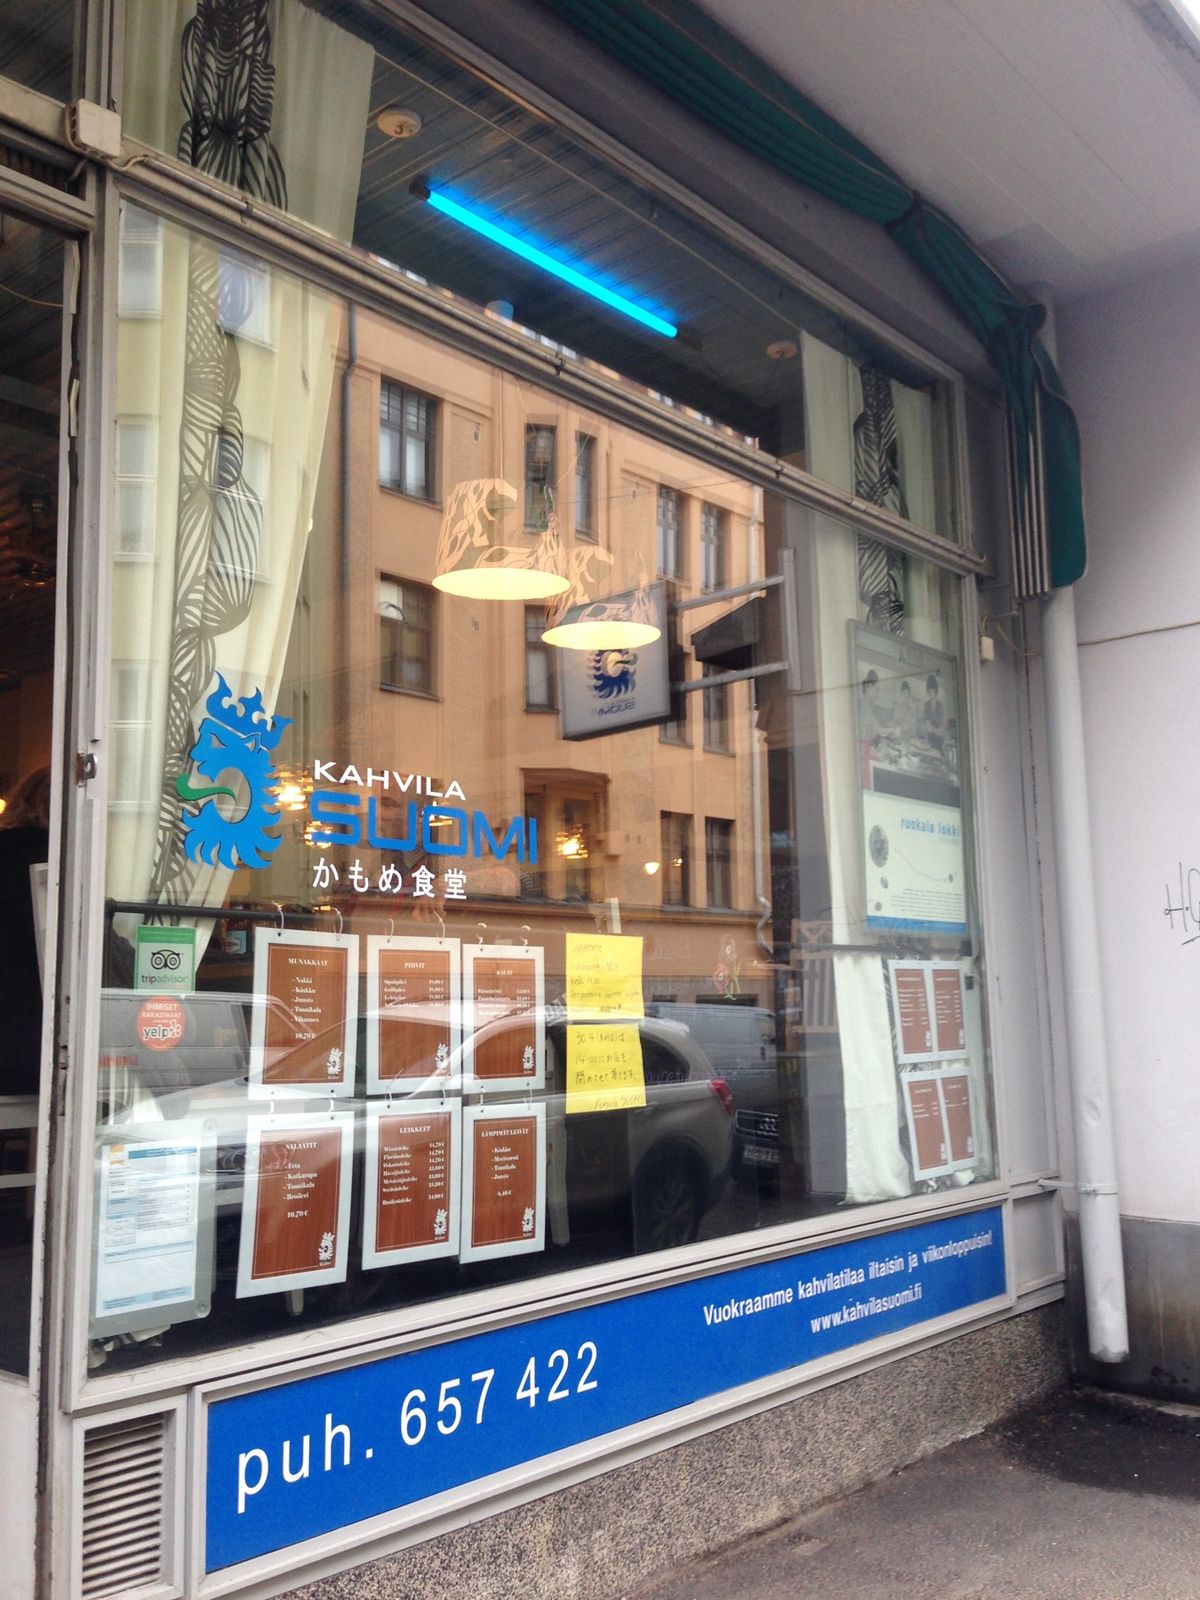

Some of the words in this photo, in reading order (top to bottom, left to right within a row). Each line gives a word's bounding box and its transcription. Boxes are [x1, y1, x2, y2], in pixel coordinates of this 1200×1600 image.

[314, 759, 467, 800] KAHVILA
[309, 789, 538, 865] SUOMI
[312, 857, 467, 900] かもめ食堂
[288, 957, 329, 966] MUNAKKAAT
[141, 973, 187, 985] tripadvisor
[146, 1003, 178, 1011] IHMISET
[143, 1024, 170, 1040] yelp
[399, 1125, 432, 1134] LEIKKEET
[286, 1142, 319, 1150] SALAATIT
[703, 1288, 794, 1326] Vuokraamme
[797, 1269, 865, 1299] kahvilatilaa
[868, 1256, 905, 1280] iltaisin
[908, 1251, 919, 1273] ja
[922, 1229, 993, 1264] viikonloppuisin!
[810, 1282, 923, 1333] www.kahvilasuomi.fi
[237, 1413, 374, 1514] puh.
[400, 1368, 496, 1446] 657
[516, 1341, 599, 1408] 422
